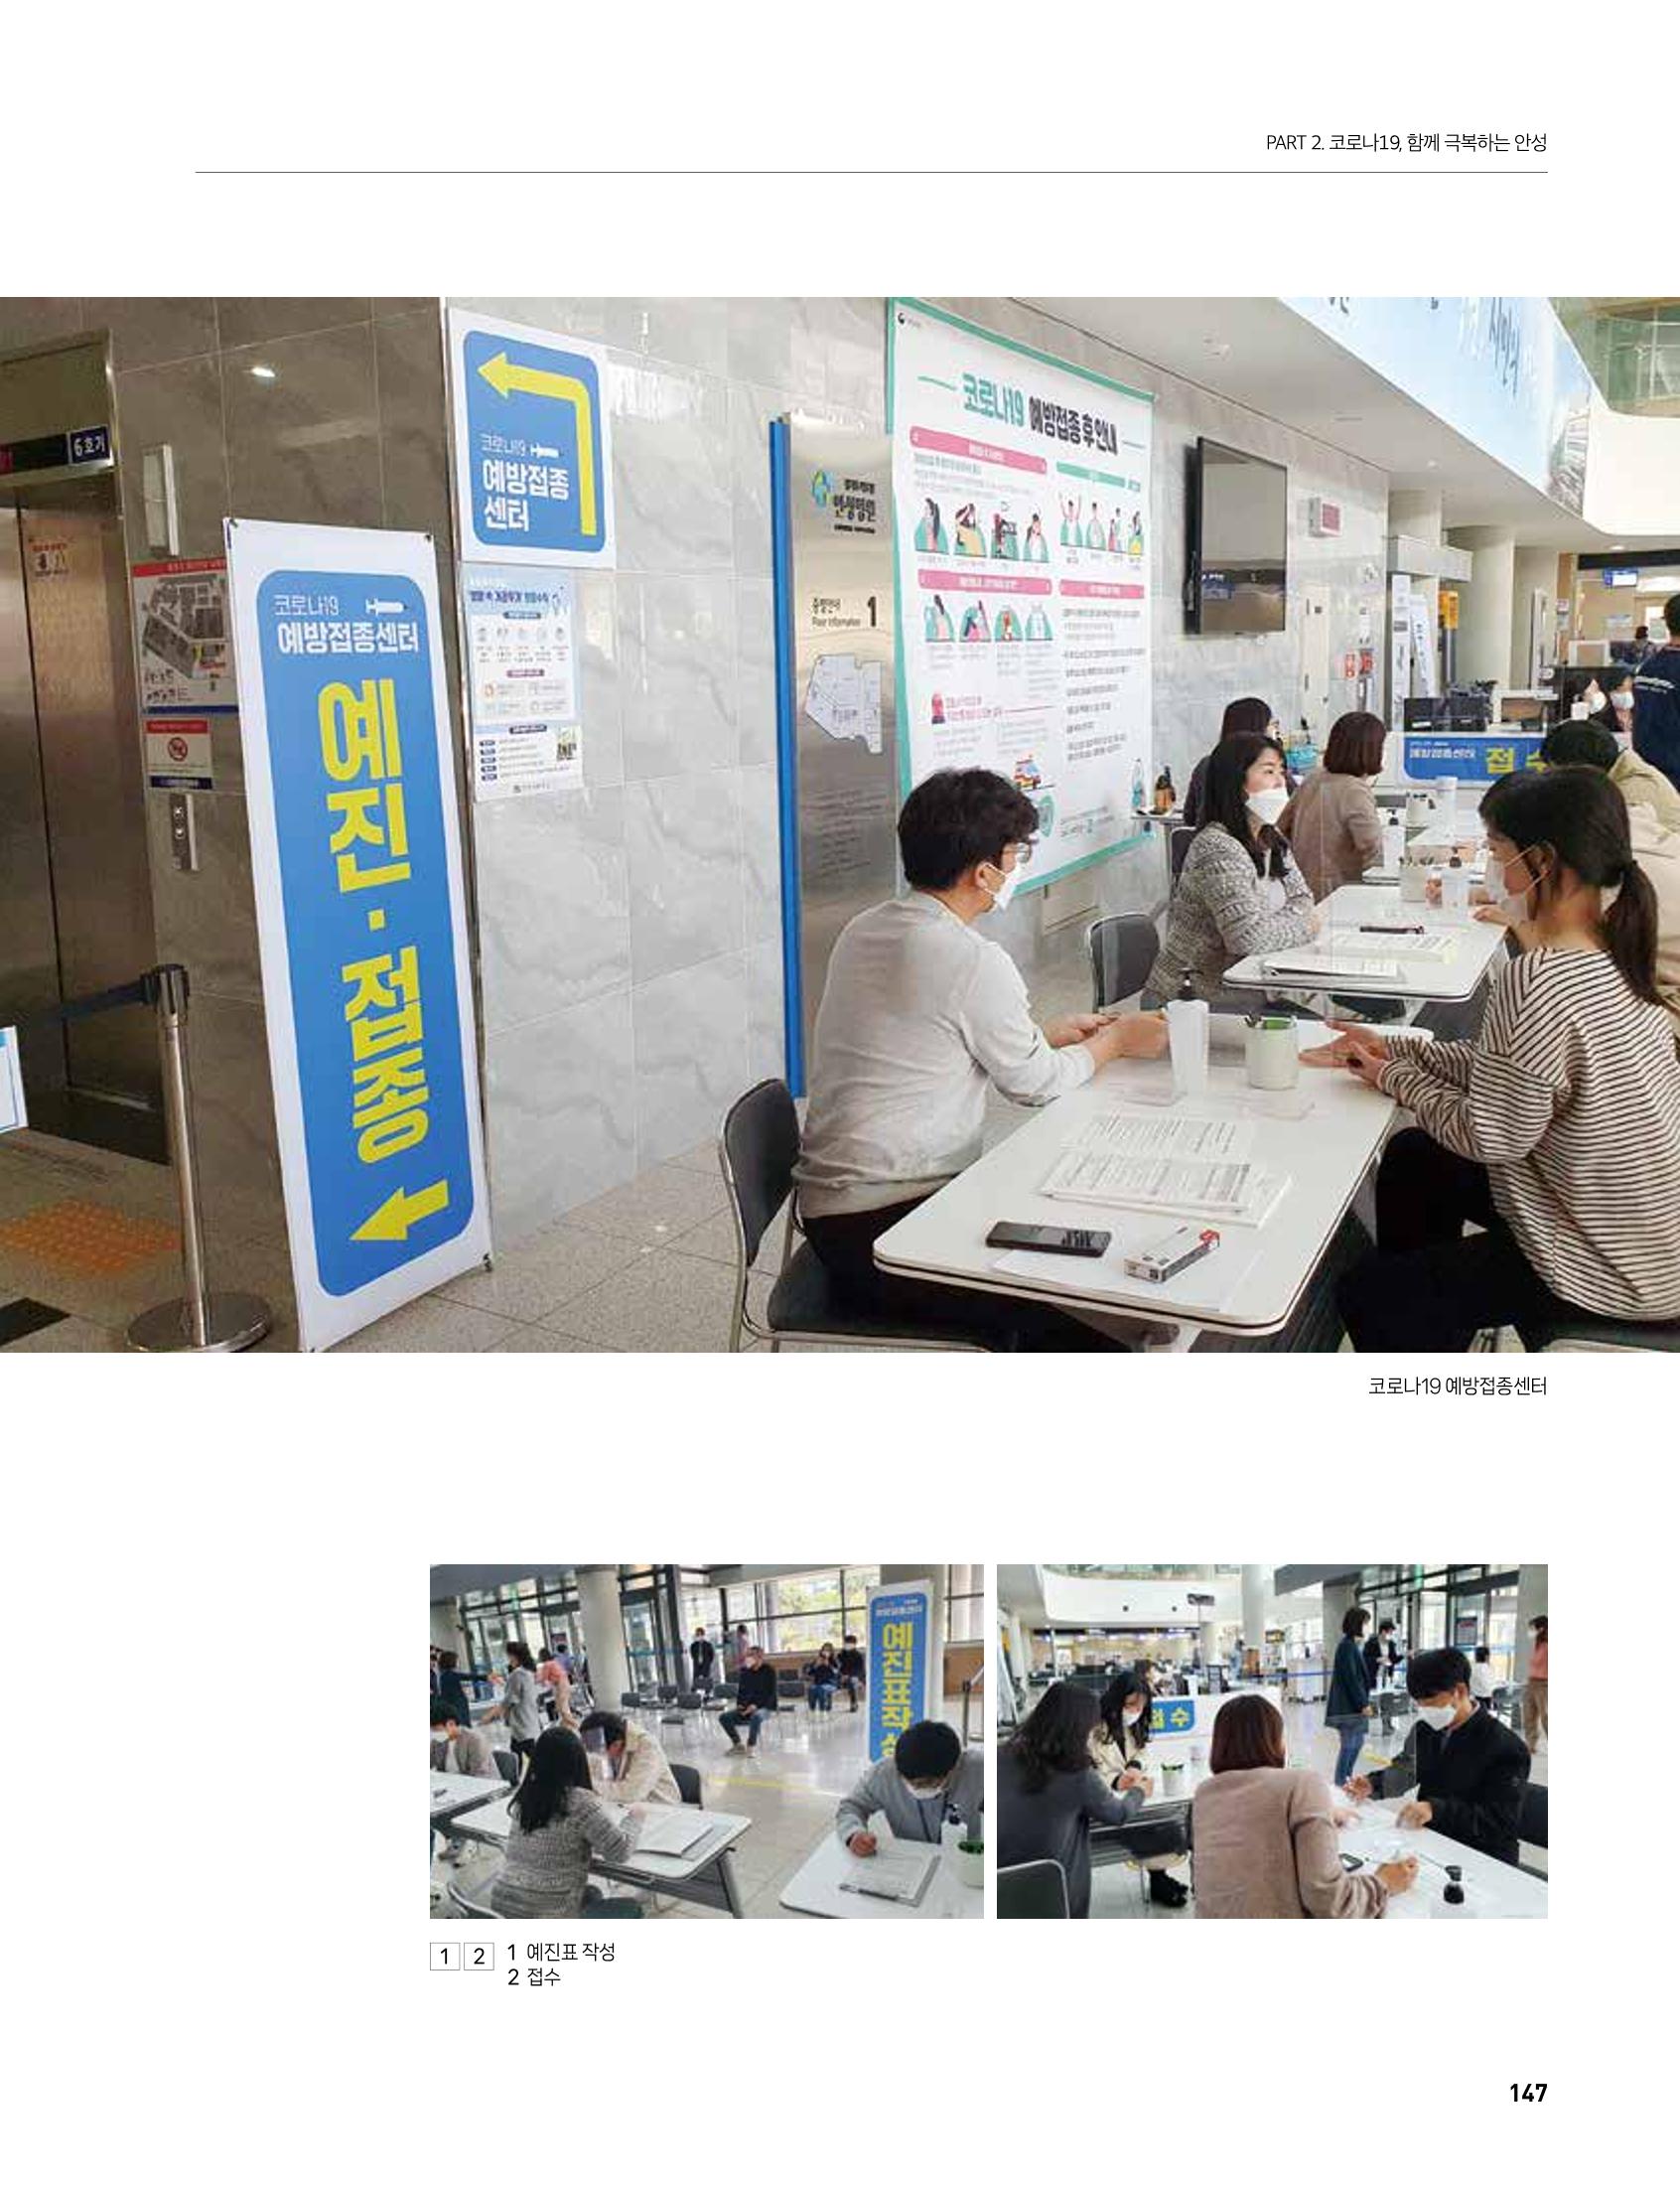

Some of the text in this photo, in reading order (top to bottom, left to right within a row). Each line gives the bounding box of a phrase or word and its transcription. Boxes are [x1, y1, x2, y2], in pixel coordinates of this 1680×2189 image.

[961, 372, 1025, 427] 코로나19
[73, 435, 105, 458] 6호기
[481, 433, 526, 457] 코로나19
[483, 459, 570, 502] 예방접종
[484, 496, 530, 532] 센터
[273, 594, 340, 617] 코로나19
[867, 596, 877, 628] 1
[277, 621, 419, 655] 예방접종센터
